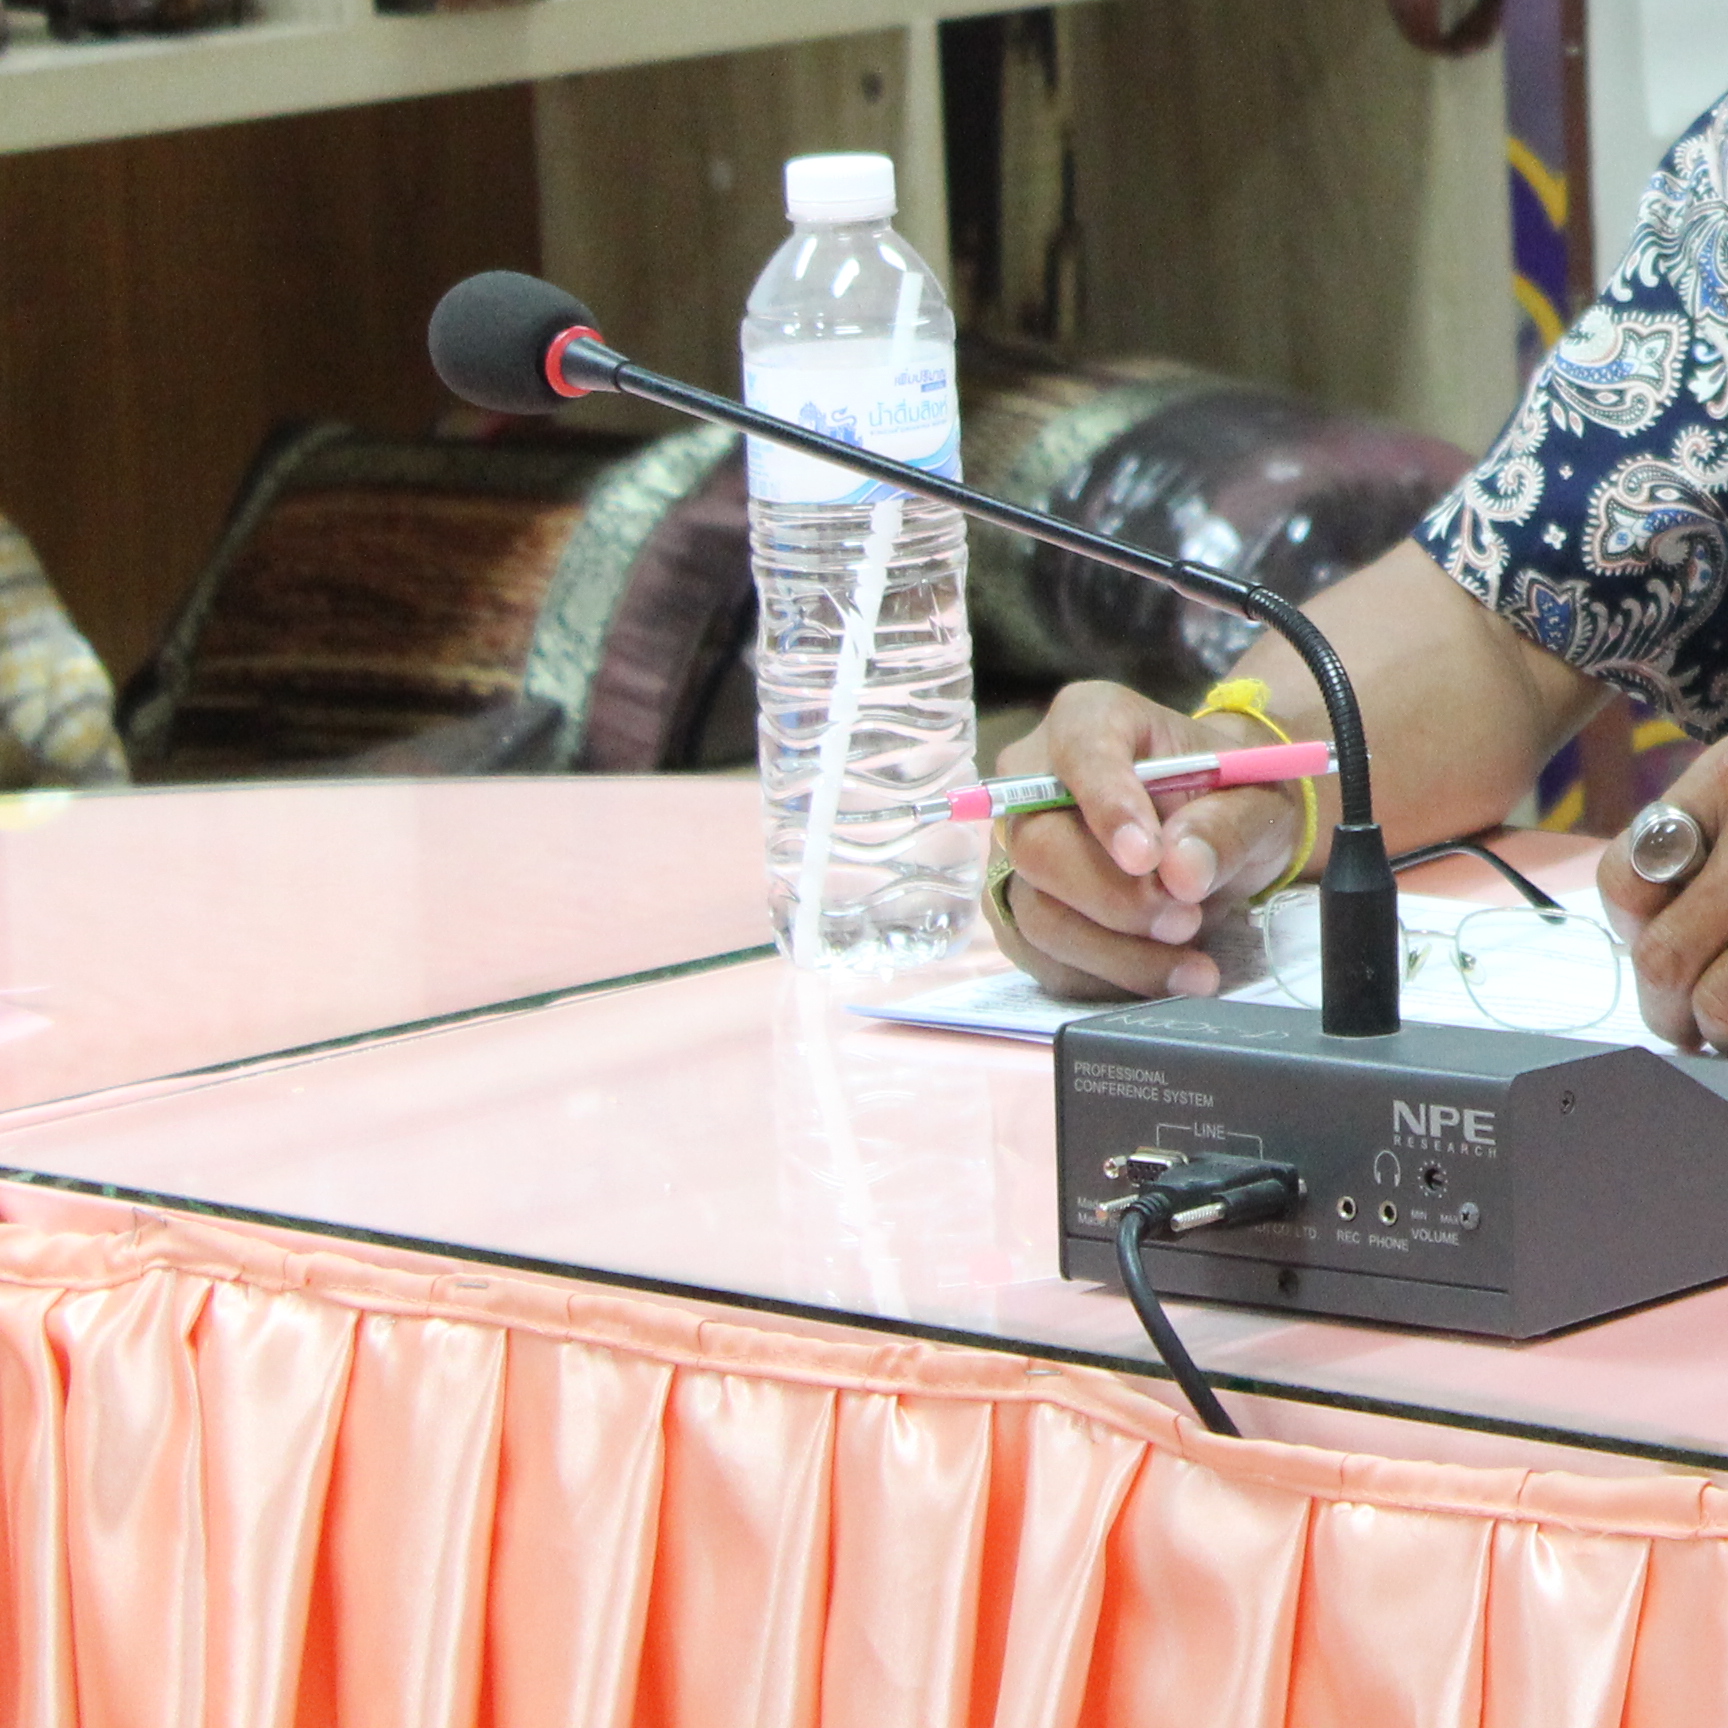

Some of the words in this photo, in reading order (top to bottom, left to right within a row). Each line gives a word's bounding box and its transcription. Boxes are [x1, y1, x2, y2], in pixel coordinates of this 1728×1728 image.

[1073, 1061, 1169, 1086] PROFESSIONAL
[1073, 1078, 1159, 1102] CONFERENCE
[1162, 1089, 1214, 1108] SYSTEM
[1193, 1122, 1226, 1141] LINE
[1392, 1099, 1497, 1146] NPE
[1393, 1134, 1498, 1159] RESEARCH
[1336, 1229, 1361, 1245] REC
[1368, 1234, 1410, 1252] PHONE
[1411, 1228, 1460, 1247] VOLUME
